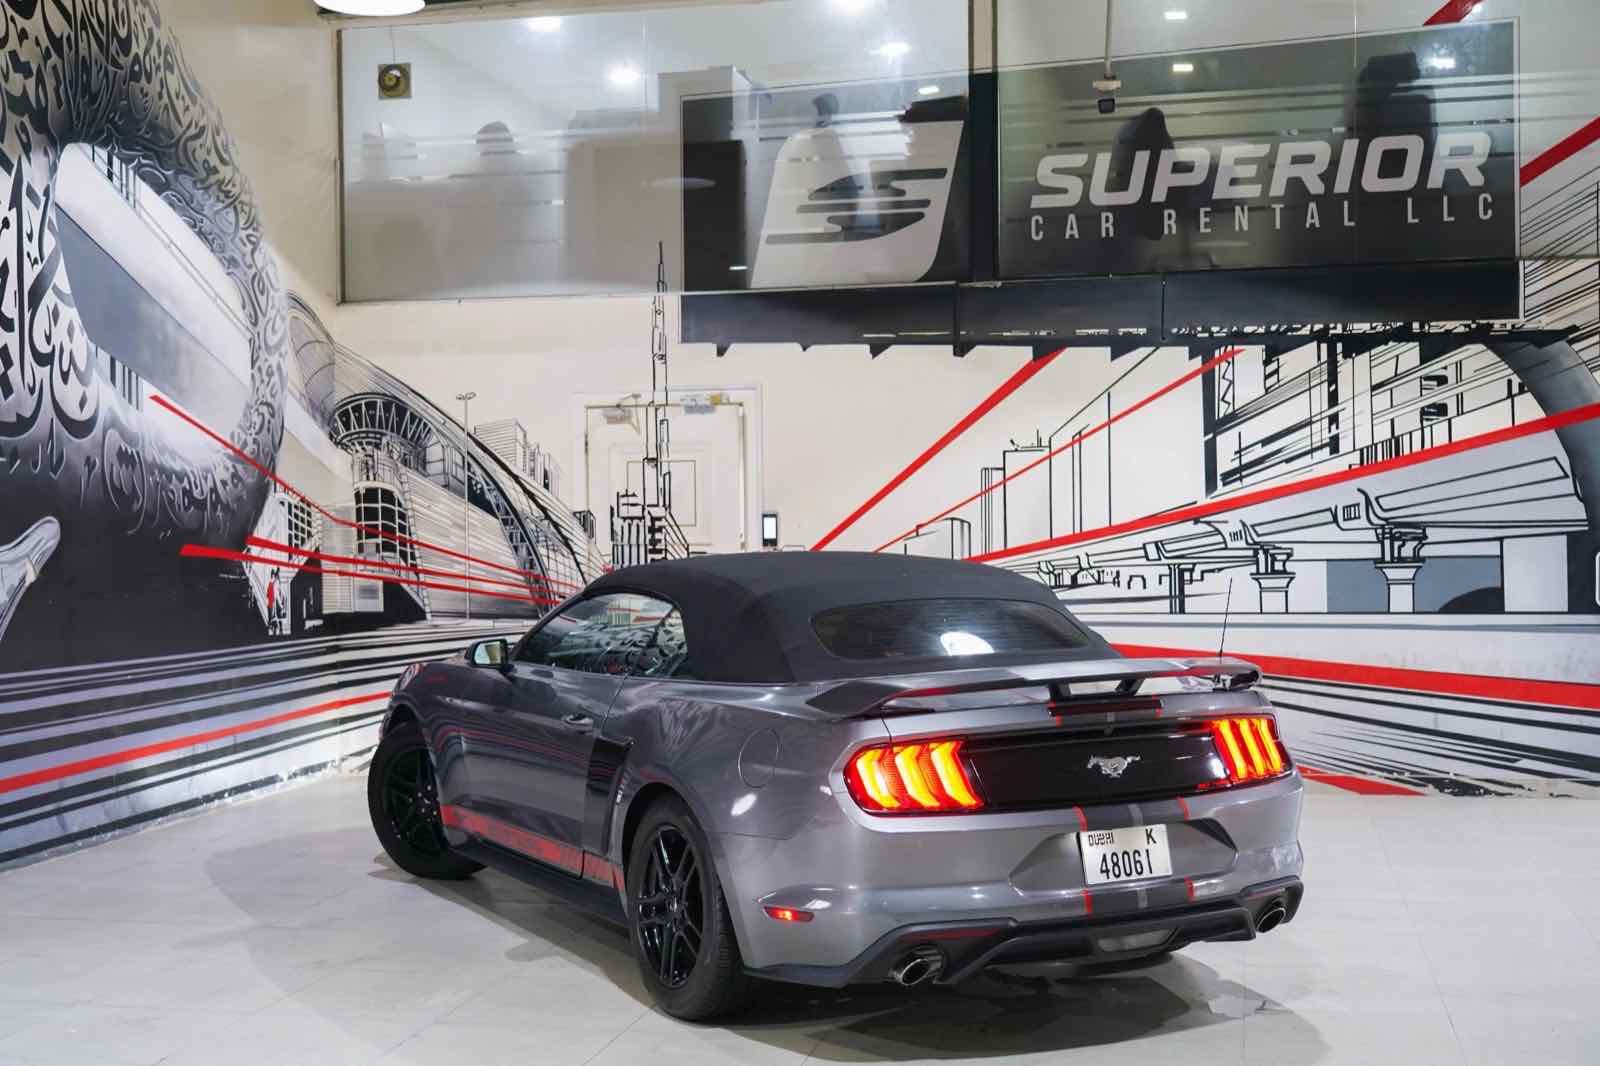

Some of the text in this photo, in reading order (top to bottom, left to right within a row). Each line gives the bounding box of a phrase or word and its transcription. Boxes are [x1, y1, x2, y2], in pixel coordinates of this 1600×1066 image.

[1031, 132, 1493, 209] SUPERIOR
[1031, 193, 1494, 241] CAR RENTAL LLC
[1145, 828, 1157, 845] K
[1100, 849, 1153, 879] 48061
